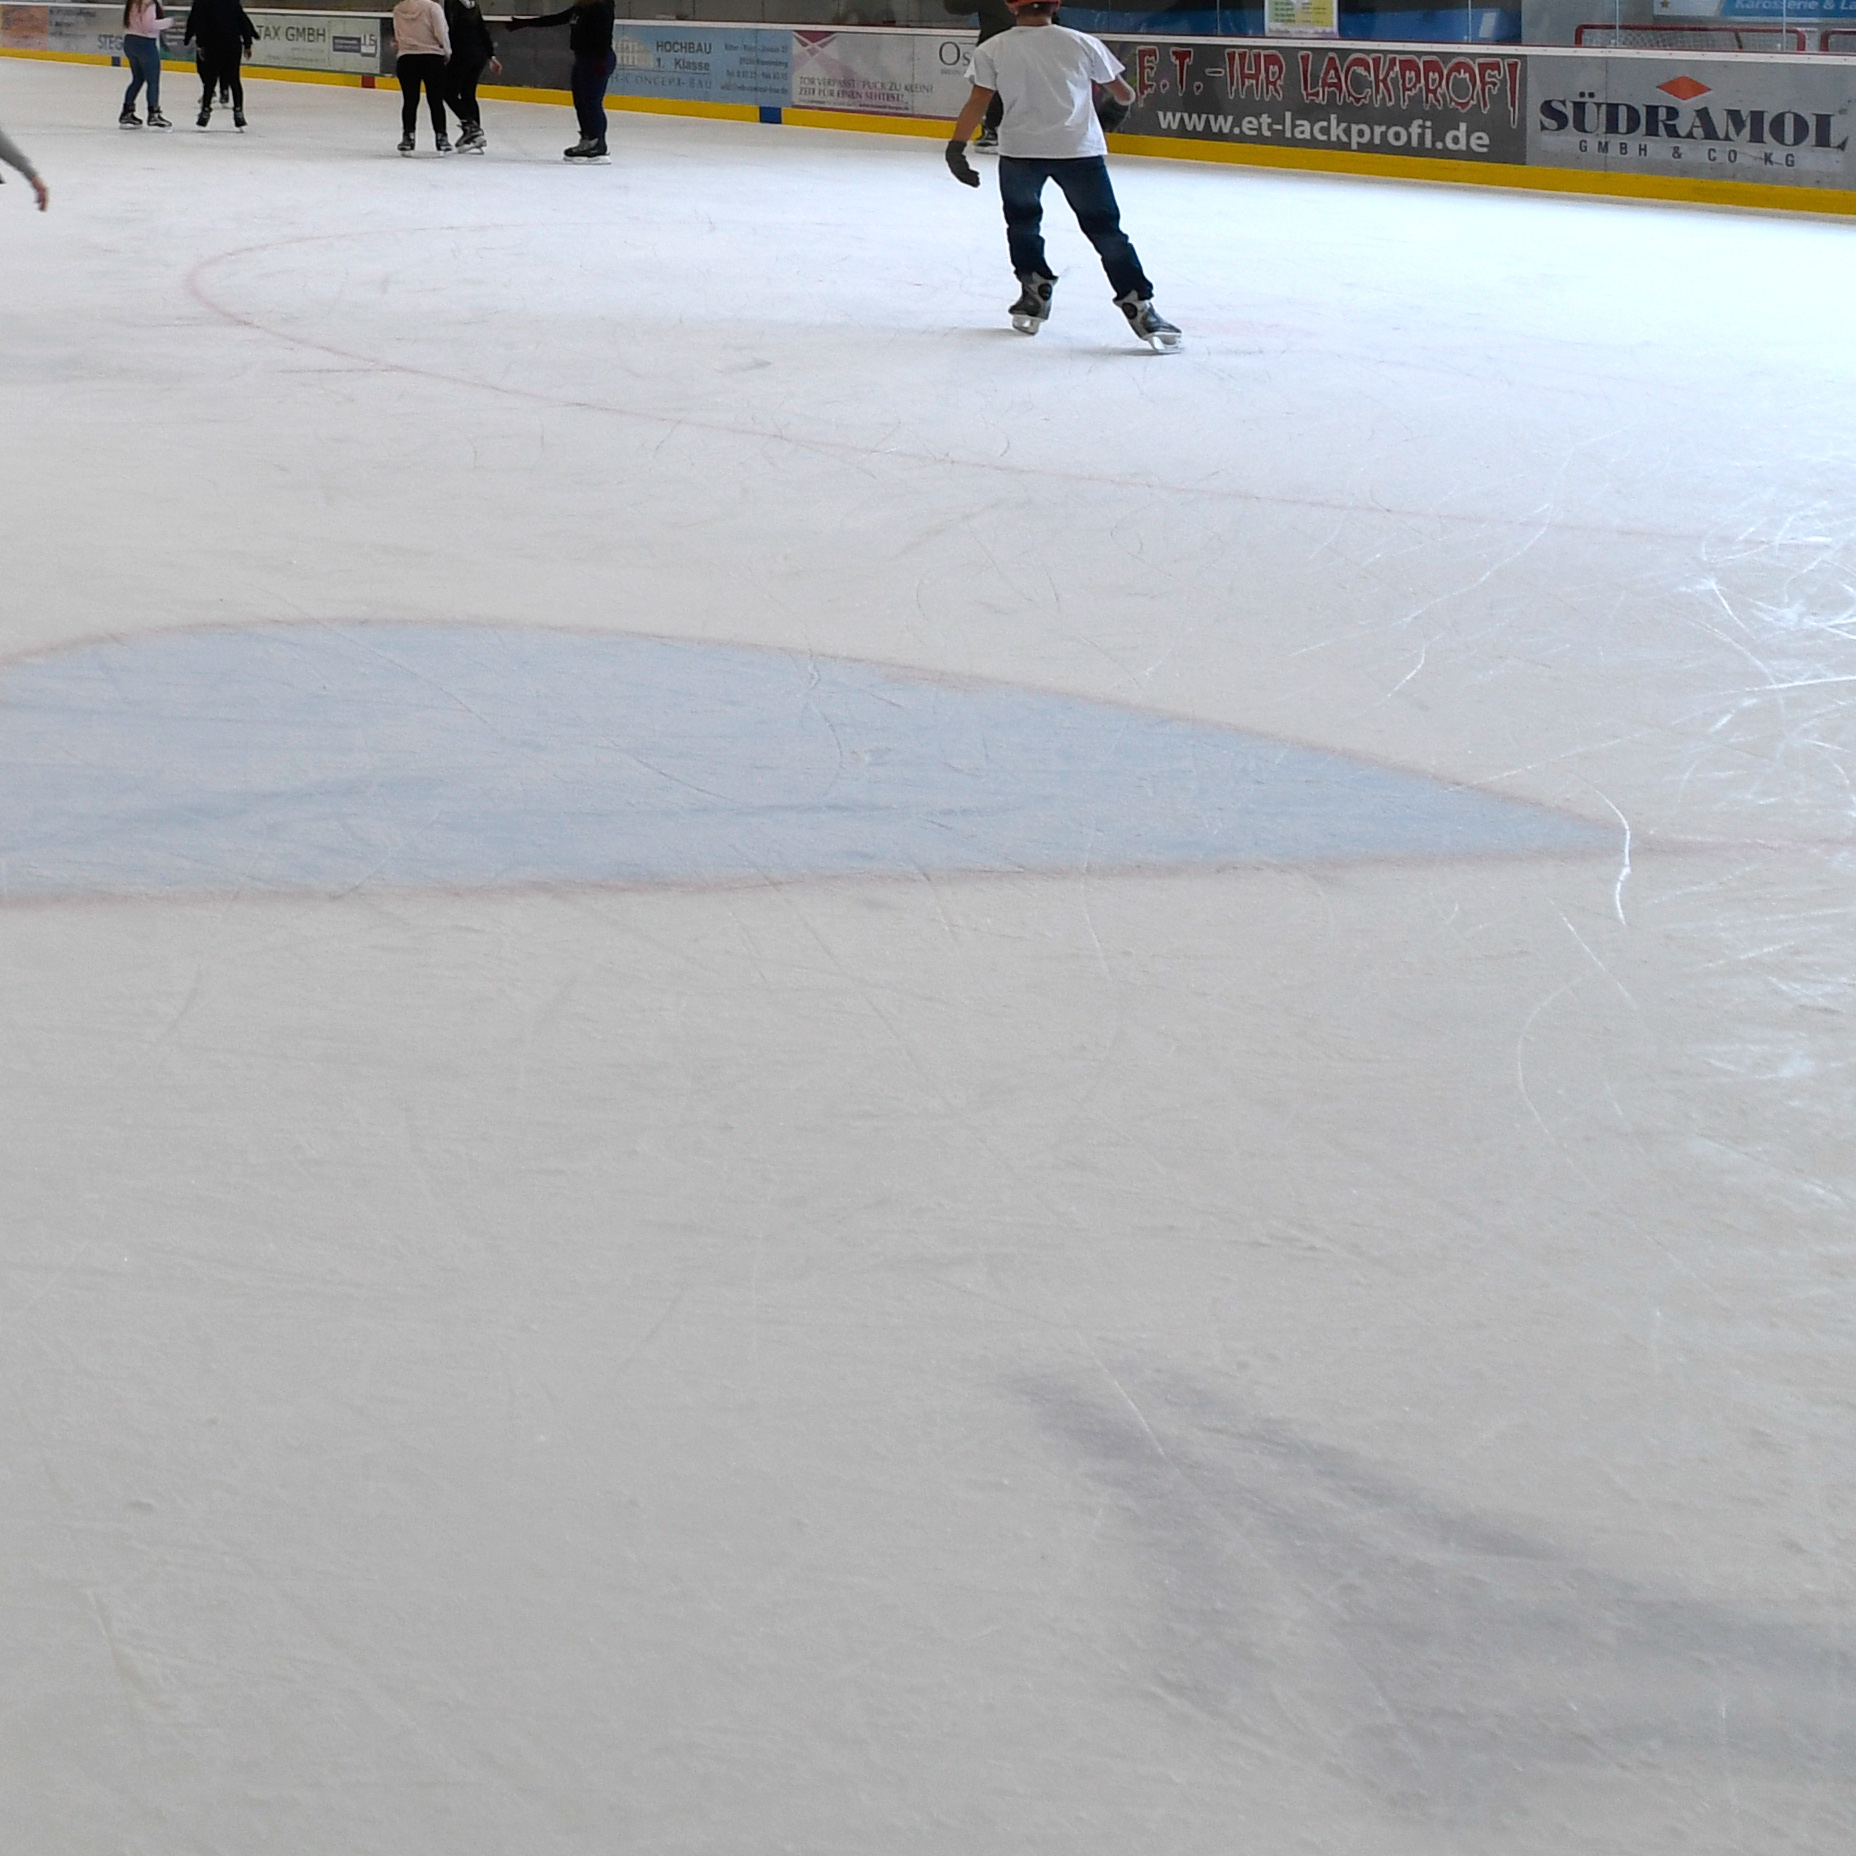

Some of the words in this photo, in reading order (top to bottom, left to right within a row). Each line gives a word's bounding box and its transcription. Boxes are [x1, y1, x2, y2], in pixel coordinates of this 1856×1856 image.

[285, 26, 327, 43] GMBH
[656, 40, 712, 54] HOCHBAU
[674, 57, 710, 72] Klasse
[888, 81, 902, 92] ZU
[1298, 49, 1521, 128] LACKPROFI
[1157, 110, 1491, 154] www.et-lackprofi.de
[1539, 92, 1850, 152] SÜDRAMOL
[1579, 140, 1648, 158] GMBH
[1672, 146, 1683, 159] &
[1708, 147, 1739, 164] CO
[1764, 150, 1795, 167] KG
